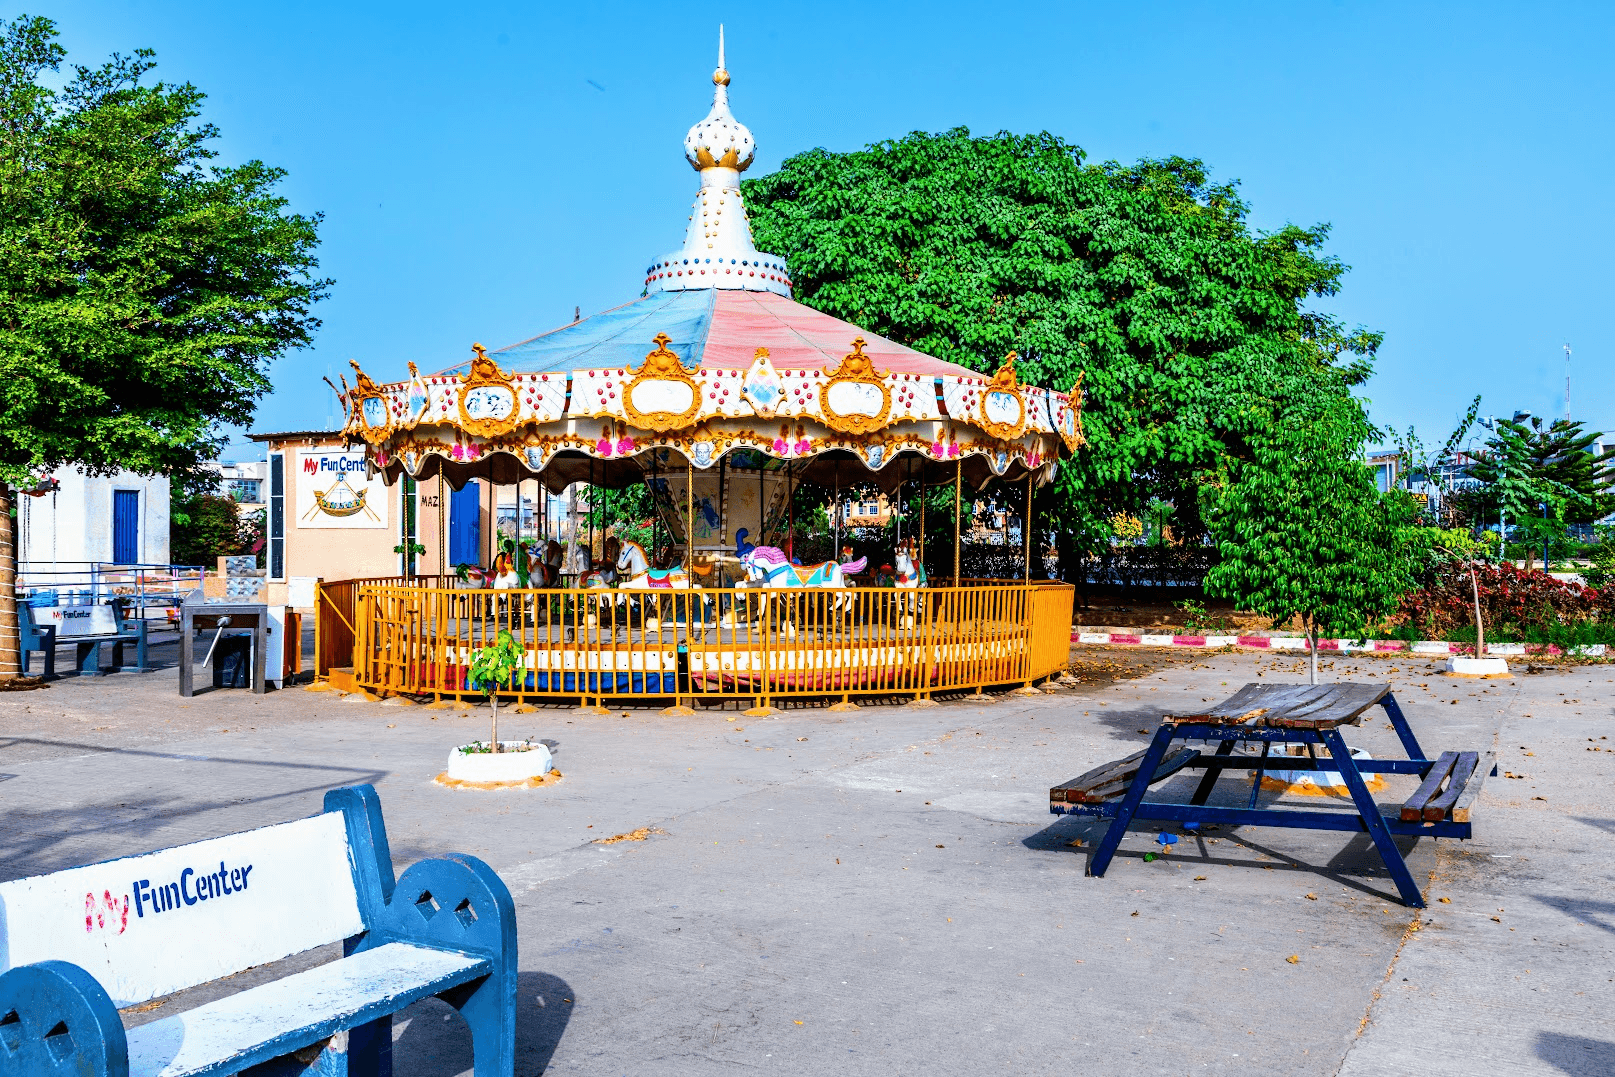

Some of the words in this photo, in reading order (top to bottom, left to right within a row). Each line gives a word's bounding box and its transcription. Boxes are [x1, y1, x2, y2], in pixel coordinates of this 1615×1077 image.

[304, 458, 319, 475] My
[321, 456, 366, 472] FunCent
[52, 611, 63, 621] My
[85, 889, 130, 936] My
[133, 861, 253, 918] FunCenter
